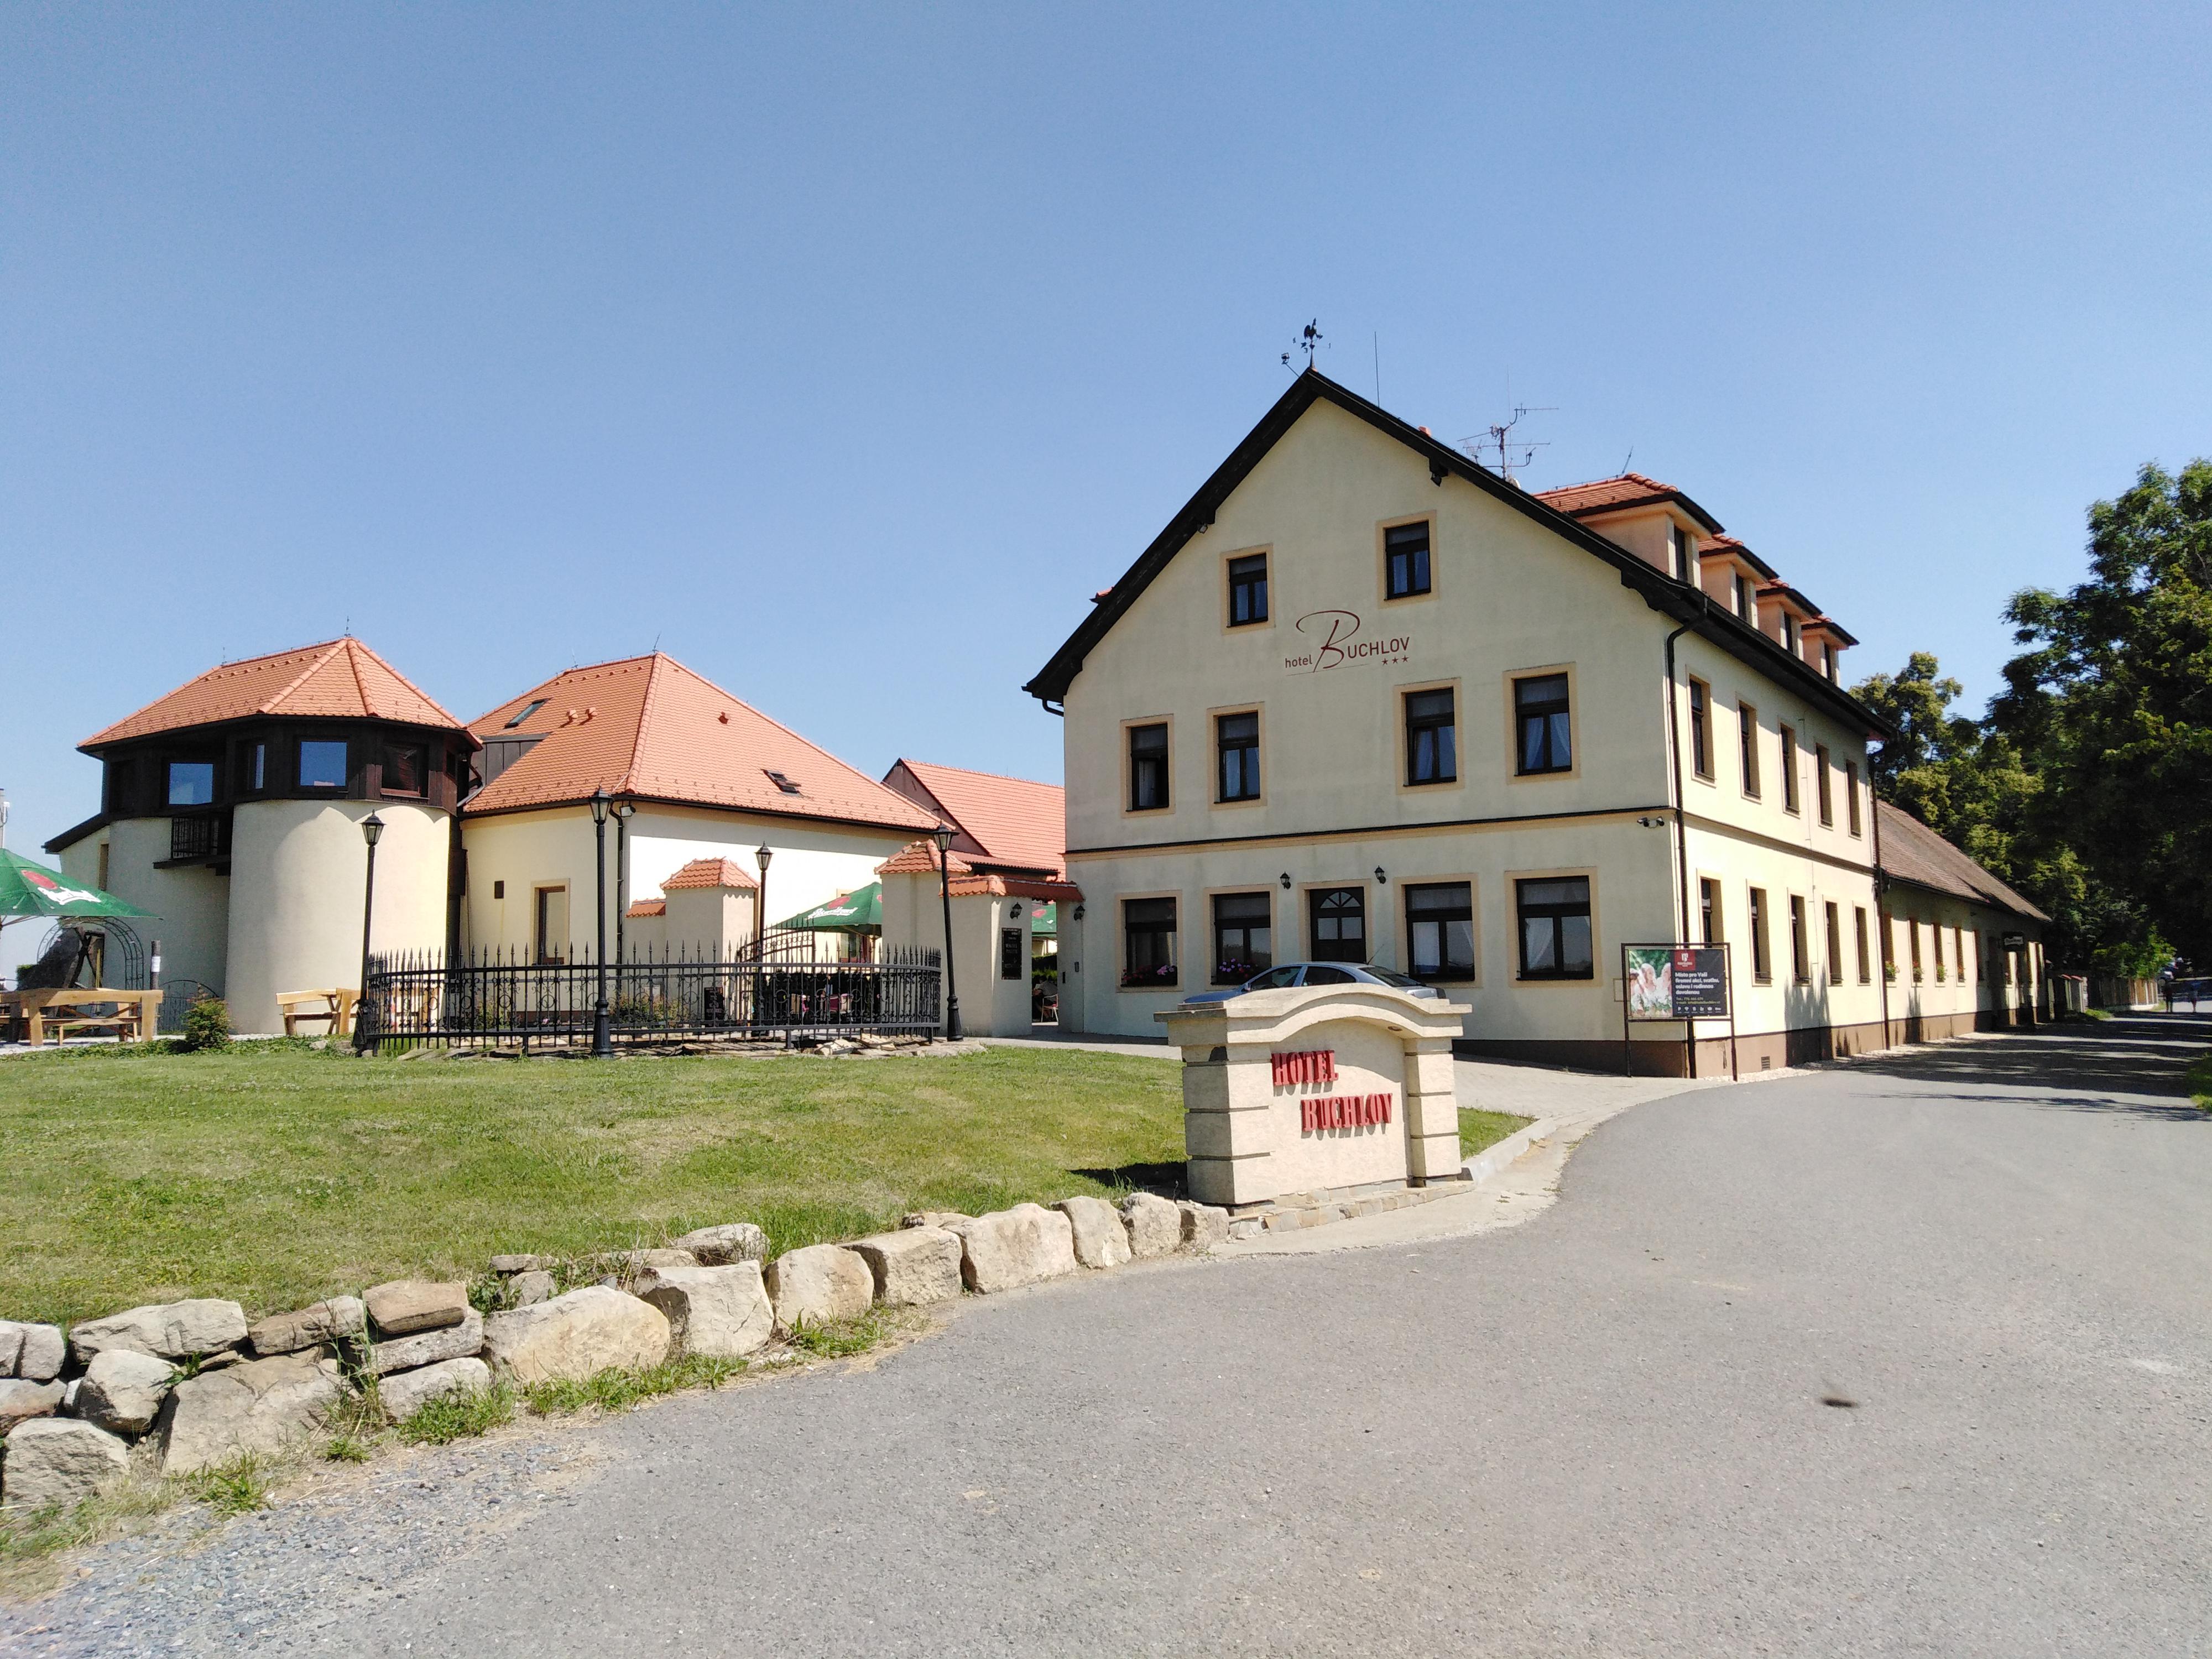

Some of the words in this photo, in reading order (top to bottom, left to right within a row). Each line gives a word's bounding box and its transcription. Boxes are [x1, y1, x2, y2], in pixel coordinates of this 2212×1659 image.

[1296, 610, 1410, 672] BUCHLOV
[1285, 655, 1312, 668] hotel
[1271, 1050, 1339, 1086] HOTEL
[1301, 1093, 1393, 1132] BUCHLOV
